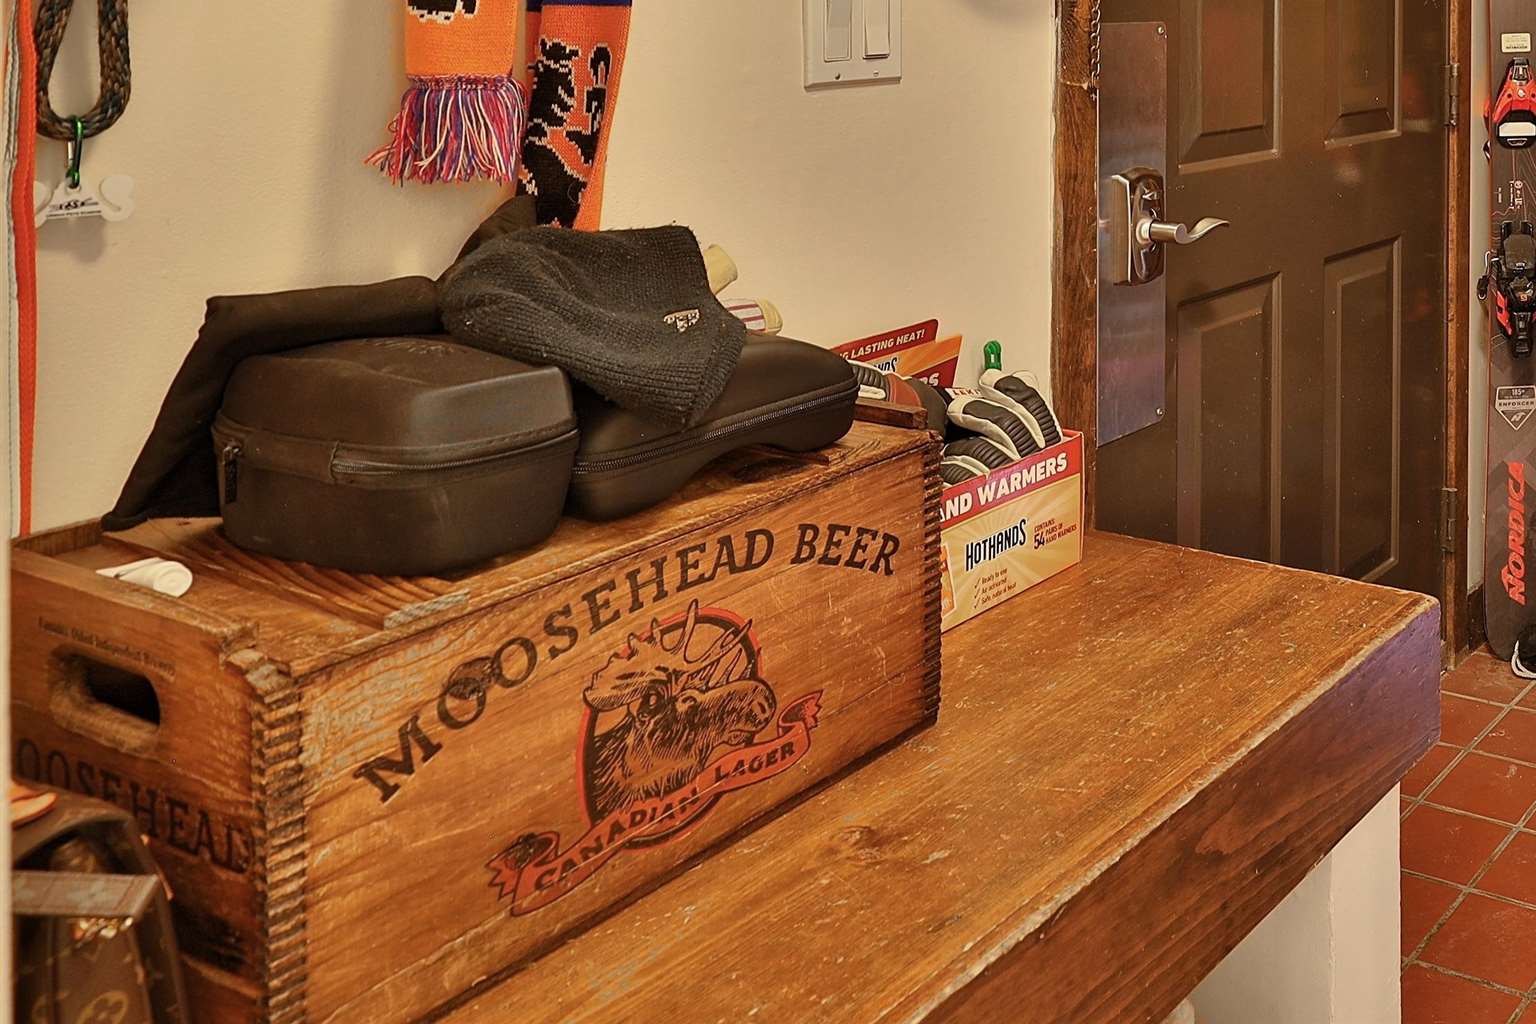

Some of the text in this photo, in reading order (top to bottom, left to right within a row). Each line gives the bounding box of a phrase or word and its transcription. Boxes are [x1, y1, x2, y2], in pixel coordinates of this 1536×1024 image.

[851, 338, 895, 359] LASTING
[896, 329, 926, 346] HEAT!
[977, 452, 1067, 506] WARMERS
[965, 518, 1027, 572] HOTHANDS
[1034, 531, 1045, 549] 54
[1501, 462, 1526, 606] NORDICA
[353, 523, 901, 804] MOOSEHEAD BEER
[714, 741, 796, 784] LAGER
[16, 738, 256, 875] OOSEHEAD
[535, 787, 699, 891] CANADIAN
